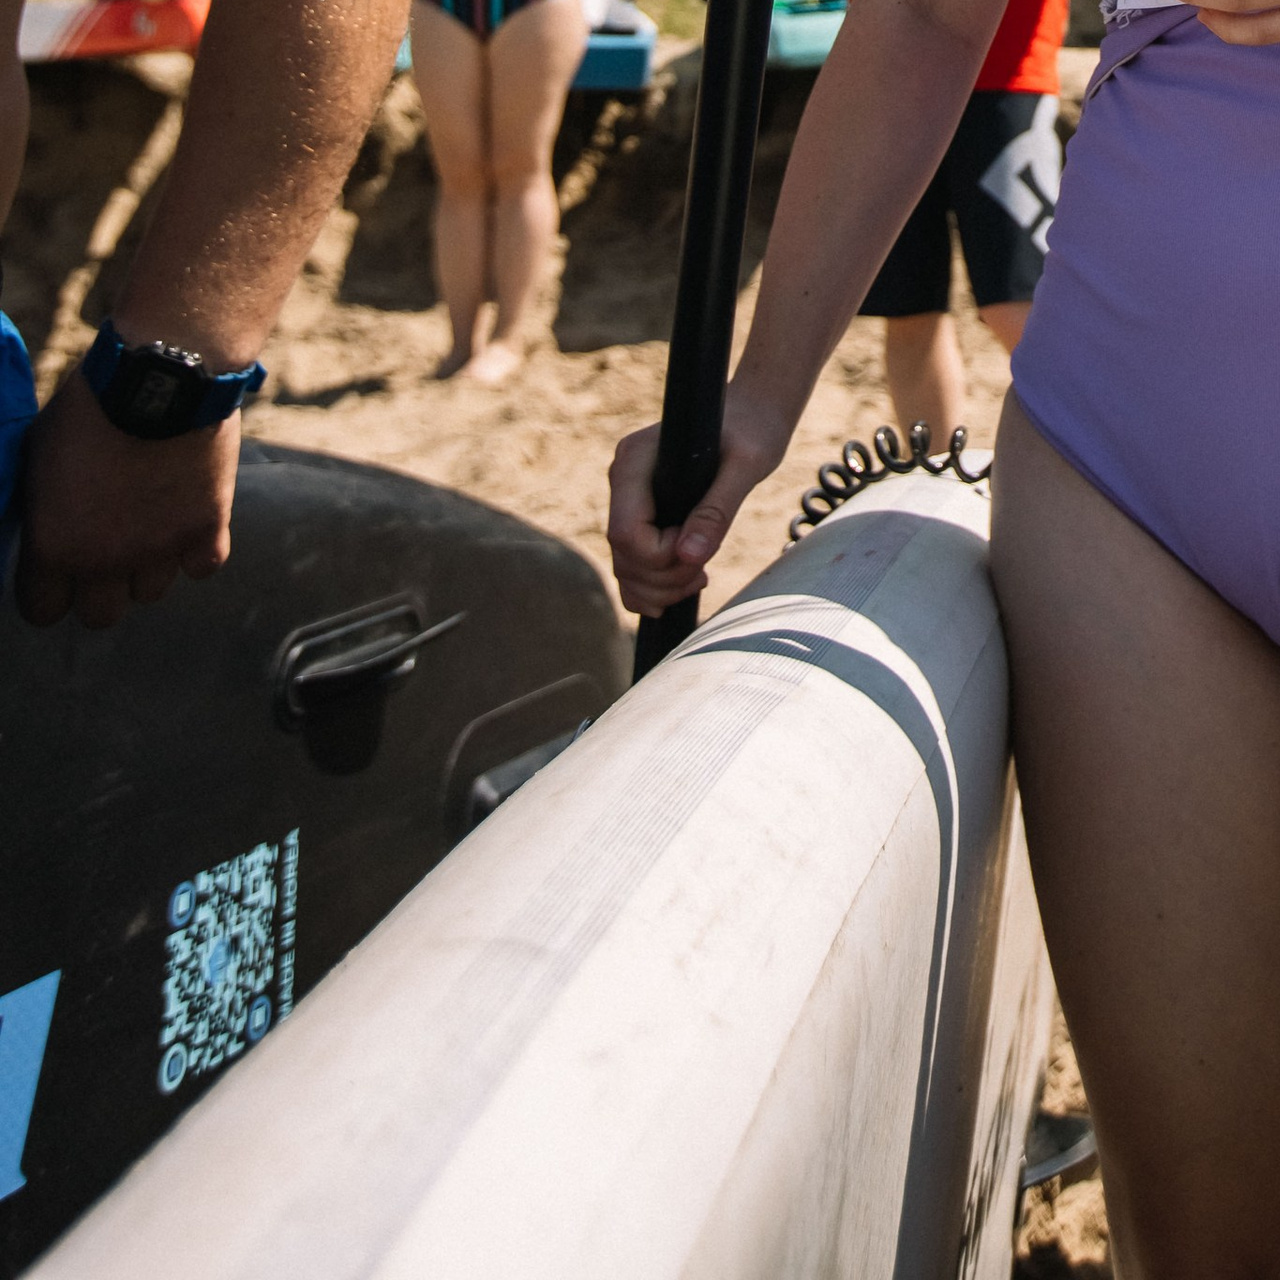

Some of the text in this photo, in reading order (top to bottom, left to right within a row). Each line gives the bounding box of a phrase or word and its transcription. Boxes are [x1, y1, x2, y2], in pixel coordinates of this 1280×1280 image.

[277, 826, 301, 1025] MADE IN KOREA
